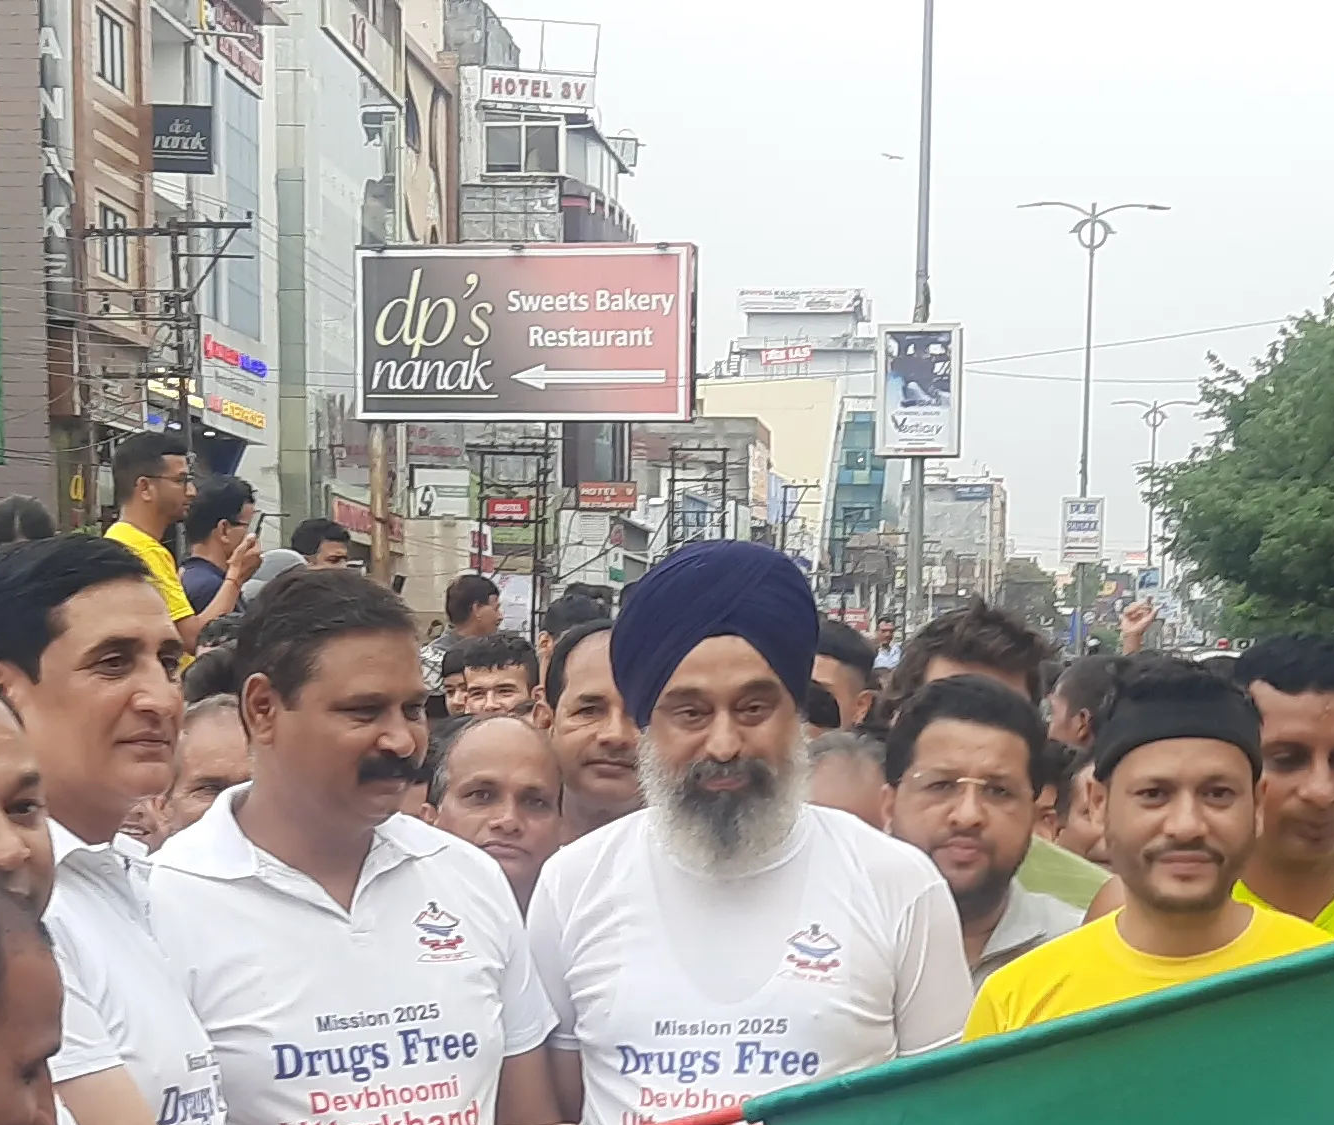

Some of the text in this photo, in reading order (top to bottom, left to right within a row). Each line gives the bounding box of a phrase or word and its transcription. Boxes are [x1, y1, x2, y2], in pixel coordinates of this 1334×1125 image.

[490, 76, 553, 99] HOTEL
[153, 131, 207, 150] nanak
[373, 266, 495, 358] dp's
[506, 288, 676, 317] Sweets Bakery
[528, 325, 654, 349] Restaurant
[370, 347, 494, 392] nanak
[315, 1002, 441, 1033] Mission 2025
[654, 1018, 789, 1037] Mission 2025
[271, 1027, 479, 1083] Drugs Free
[615, 1040, 820, 1084] Drugs Free
[309, 1074, 460, 1115] Devbhoomi
